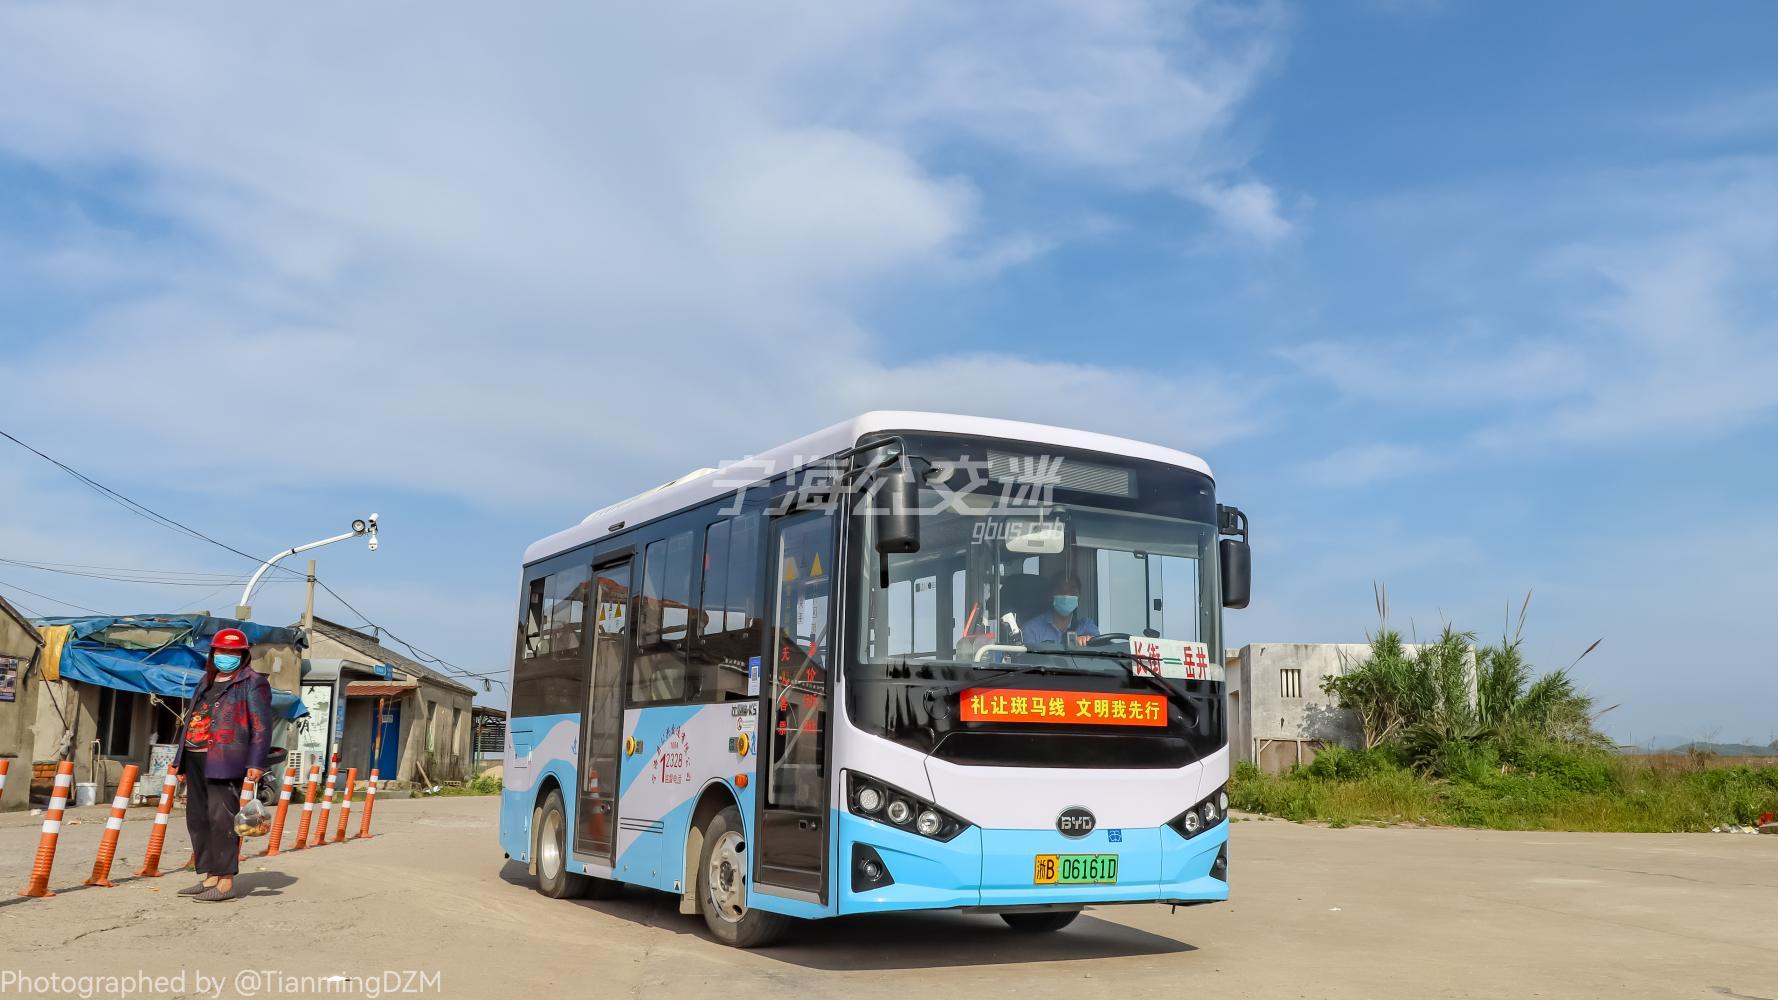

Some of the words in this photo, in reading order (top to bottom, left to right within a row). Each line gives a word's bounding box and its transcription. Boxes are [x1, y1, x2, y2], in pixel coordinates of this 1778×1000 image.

[970, 695, 1065, 718] 礼让斑马线
[1076, 698, 1160, 720] 文明我先行
[660, 753, 683, 783] 12328
[1061, 816, 1092, 830] BYD
[1062, 859, 1117, 880] 06161D
